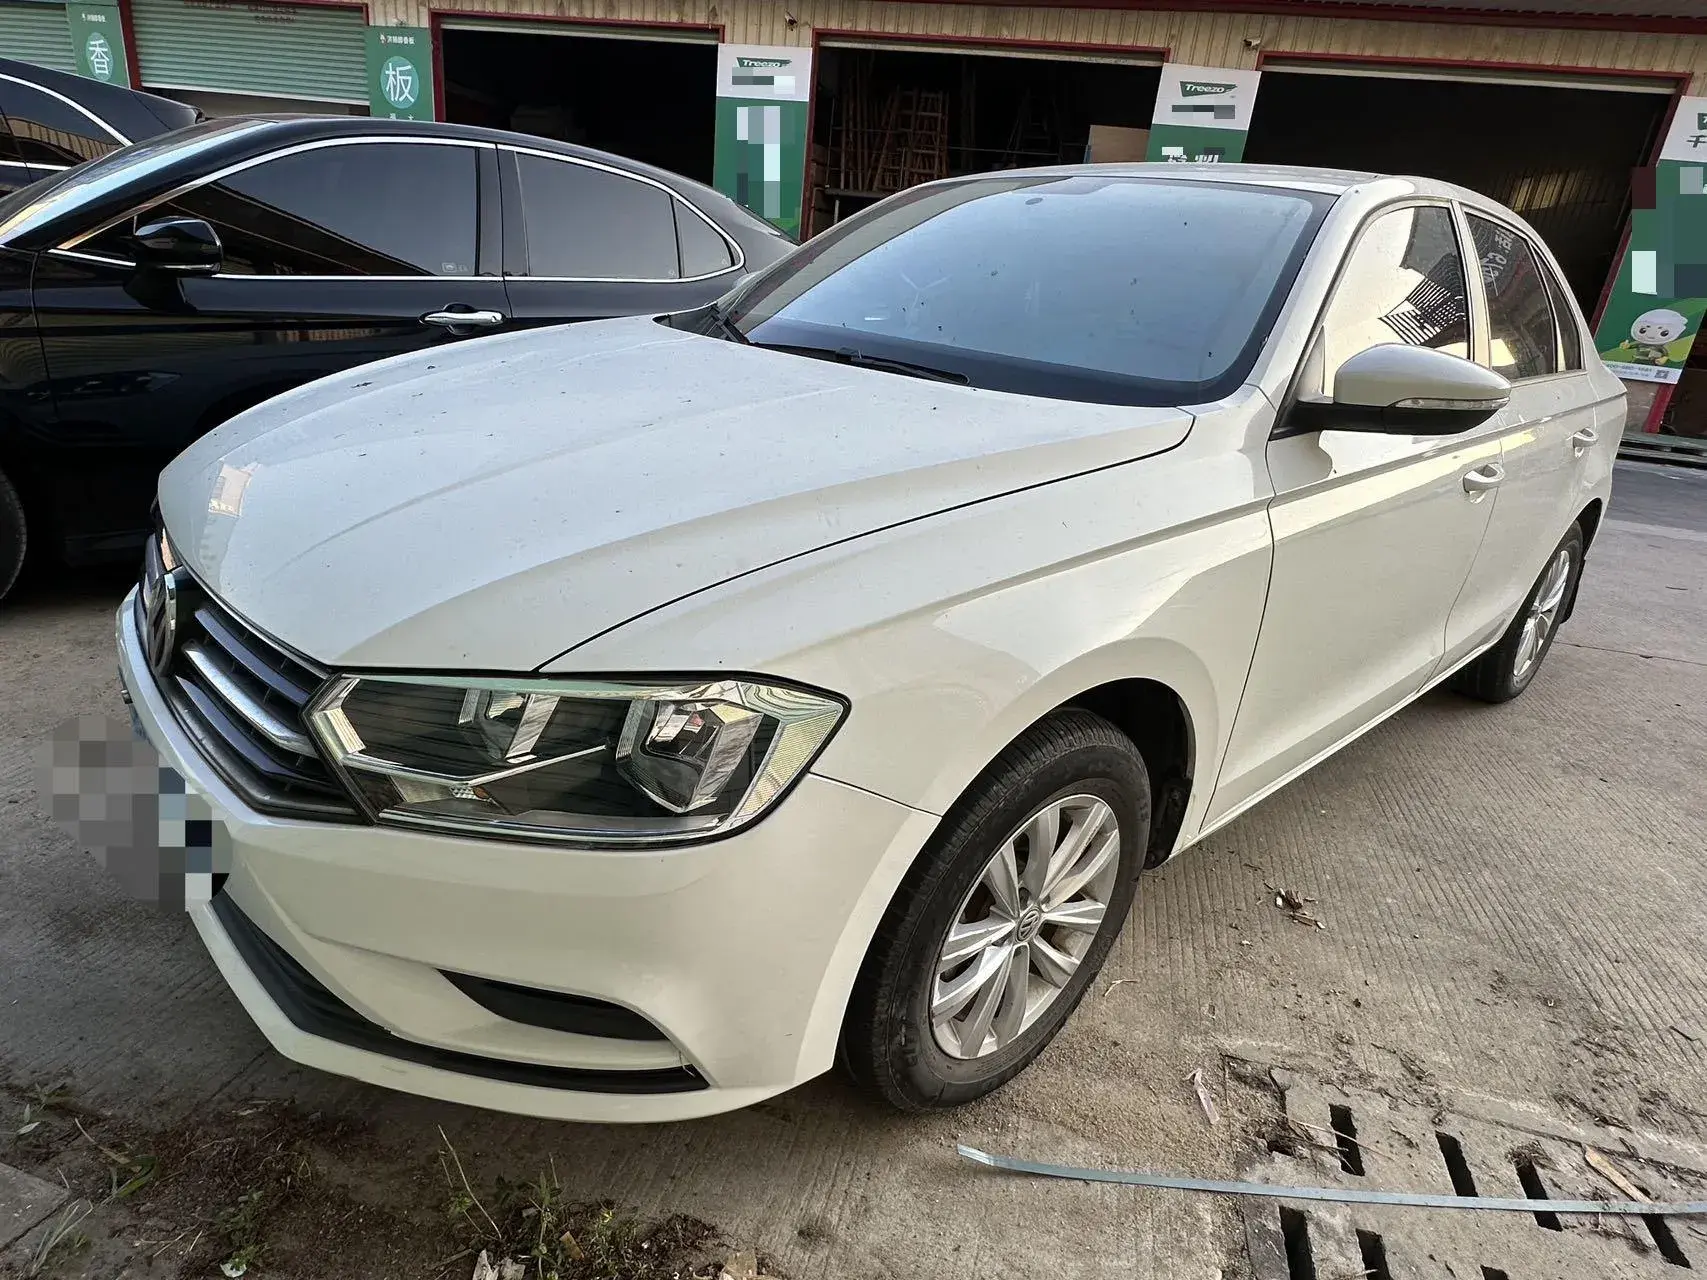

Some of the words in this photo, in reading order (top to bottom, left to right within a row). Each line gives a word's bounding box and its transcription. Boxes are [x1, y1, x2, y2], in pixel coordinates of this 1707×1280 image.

[89, 39, 109, 75] 香
[742, 59, 781, 67] Treezo
[386, 64, 415, 103] 板
[1186, 84, 1224, 93] Treezo
